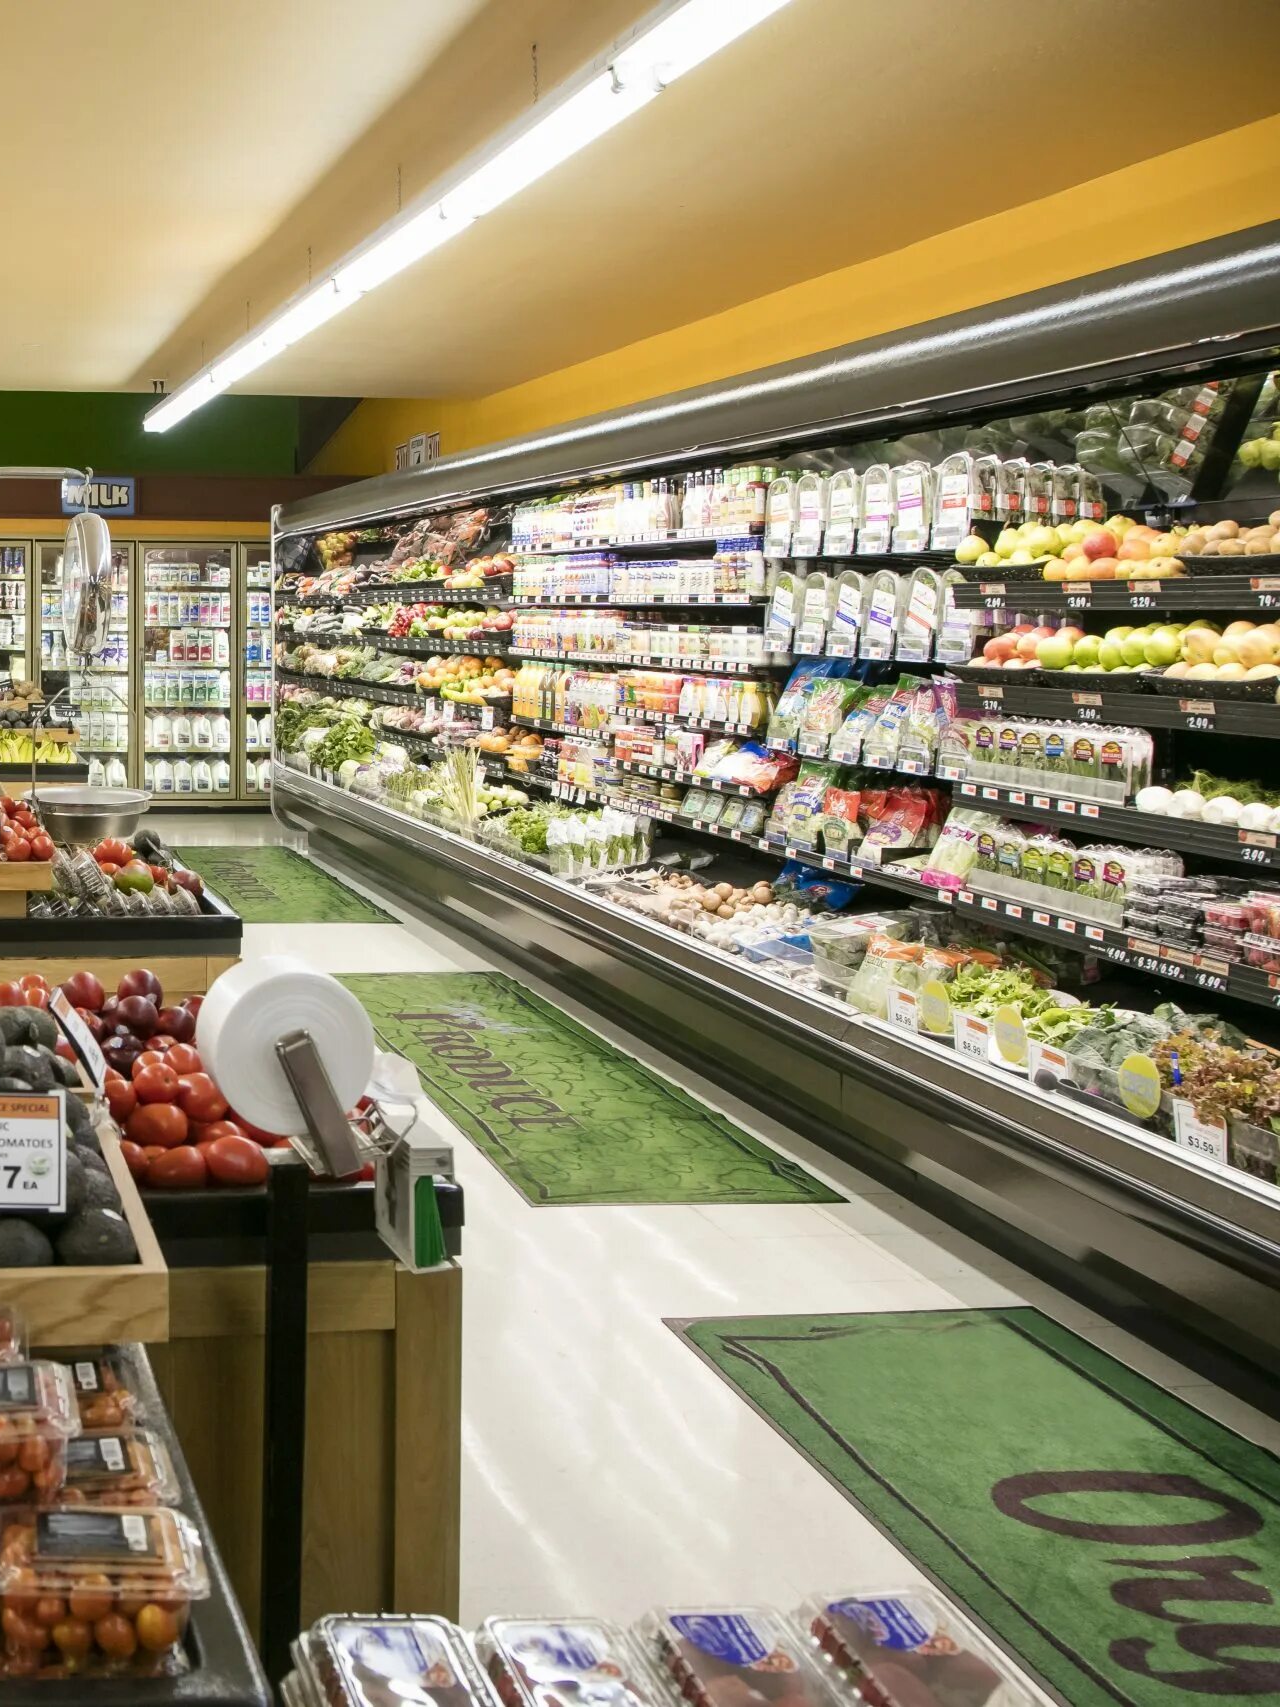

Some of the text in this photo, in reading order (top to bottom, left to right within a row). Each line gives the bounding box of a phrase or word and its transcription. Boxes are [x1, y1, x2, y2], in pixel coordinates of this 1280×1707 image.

[66, 483, 130, 507] MILK
[895, 1013, 912, 1026] $8.99
[962, 1040, 981, 1056] $8.99
[392, 1013, 588, 1132] PRODUCE
[11, 1103, 50, 1113] SPECIAL
[1187, 1135, 1214, 1155] $3.59
[23, 1181, 38, 1190] EA
